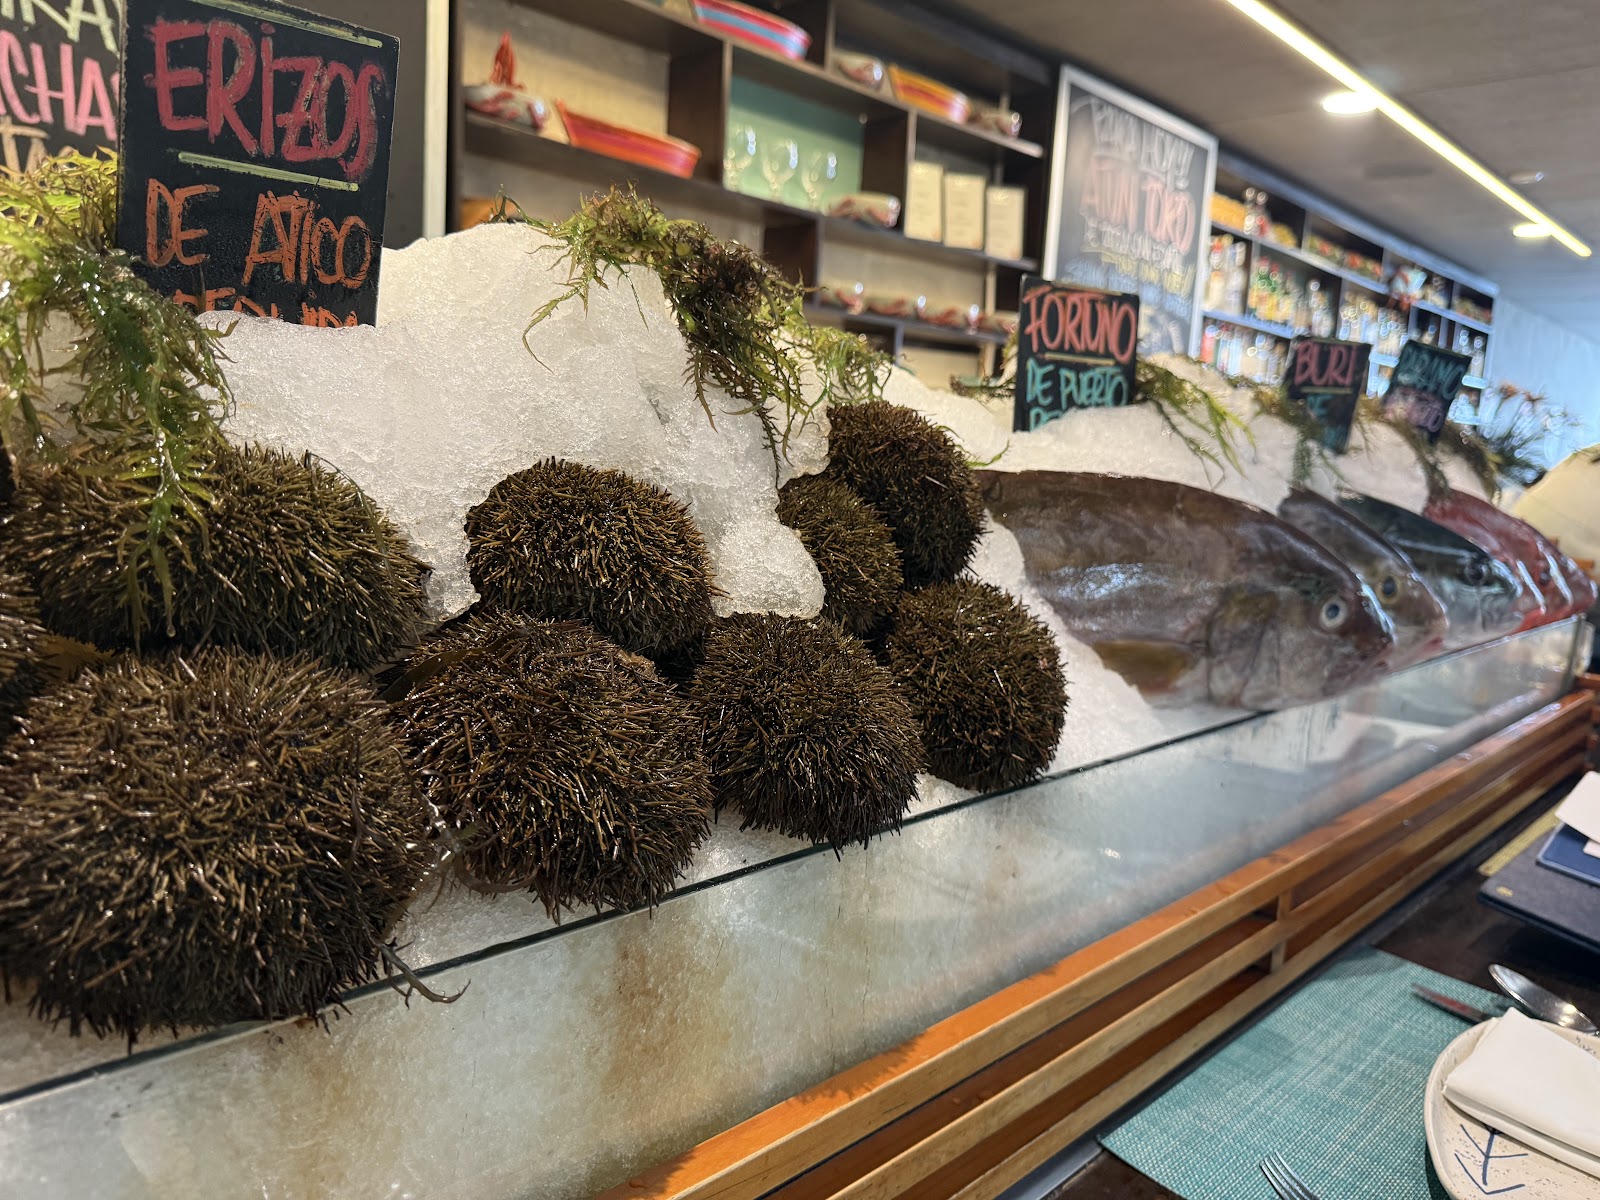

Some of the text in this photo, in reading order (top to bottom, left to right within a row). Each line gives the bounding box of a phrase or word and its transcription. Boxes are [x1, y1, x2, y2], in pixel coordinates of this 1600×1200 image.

[144, 15, 389, 182] ERIZOS
[145, 178, 220, 267] DE
[1026, 358, 1128, 410] DE PUERTO
[1293, 340, 1358, 387] BURI
